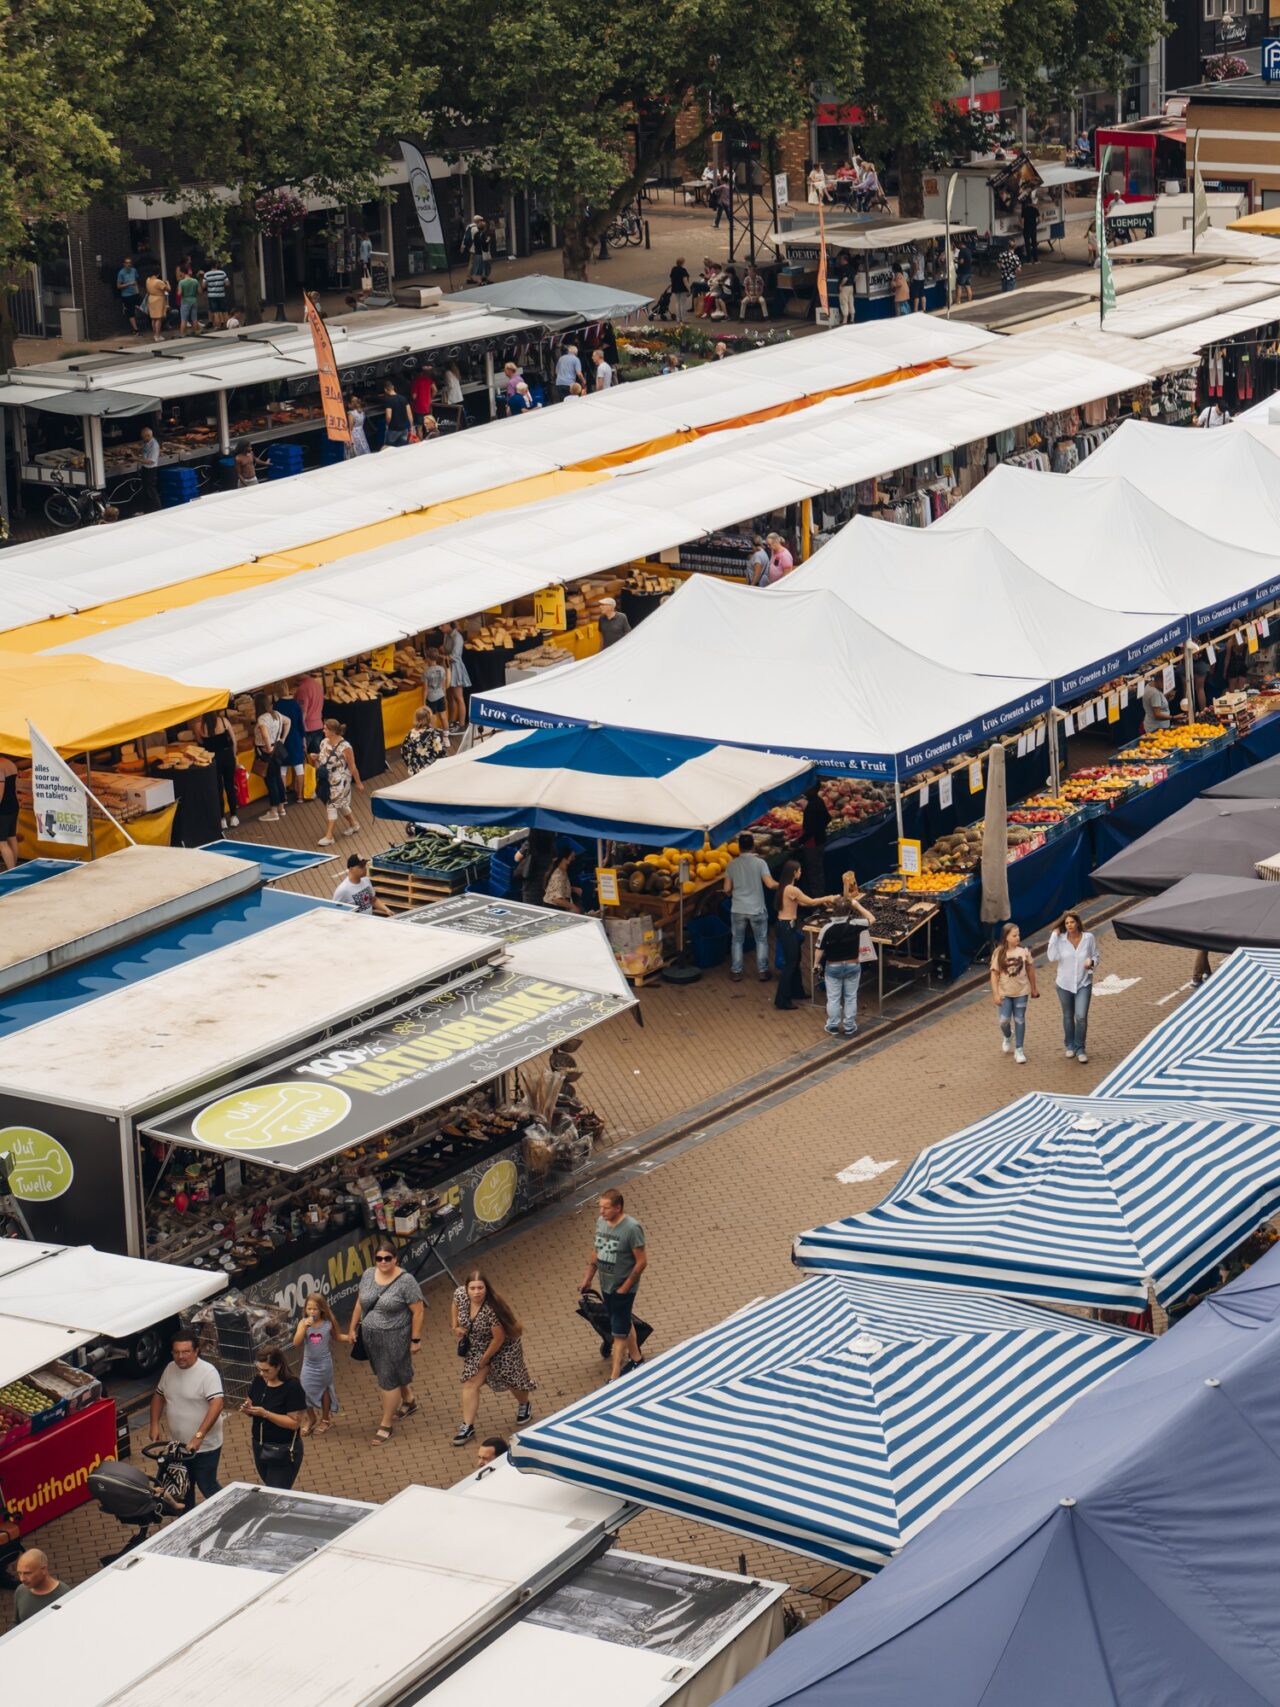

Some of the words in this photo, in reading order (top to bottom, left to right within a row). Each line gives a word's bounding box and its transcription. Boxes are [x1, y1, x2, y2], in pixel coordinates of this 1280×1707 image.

[1197, 614, 1210, 626] kros
[1127, 649, 1142, 662] kros
[1143, 637, 1164, 654] Groenten
[1163, 633, 1169, 643] &
[1169, 626, 1181, 640] Fruit
[1062, 681, 1077, 693] kros
[1078, 669, 1101, 685] Groenten
[1101, 665, 1107, 675] &
[1107, 658, 1120, 673] Fruit
[480, 704, 507, 721] kros
[510, 714, 554, 729] Groenten
[982, 718, 999, 733] kros
[1000, 707, 1024, 724] Groenten
[1024, 703, 1031, 713] &
[1031, 694, 1044, 710] Fruit
[905, 752, 923, 768] kros
[925, 742, 951, 759] Groenten
[951, 738, 958, 747] &
[958, 729, 973, 744] Fruit
[34, 765, 49, 773] alles
[849, 759, 858, 769] &
[861, 760, 887, 773] Fruit
[34, 774, 49, 782] voor
[35, 782, 77, 794] smartphone's
[36, 791, 45, 799] en
[56, 811, 83, 824] BEST
[58, 823, 83, 834] MOBILE
[328, 981, 581, 1093] NATUURLIJKE
[296, 1045, 387, 1079] 100%
[280, 1105, 336, 1135] Twelle
[16, 1175, 53, 1194] Twelle
